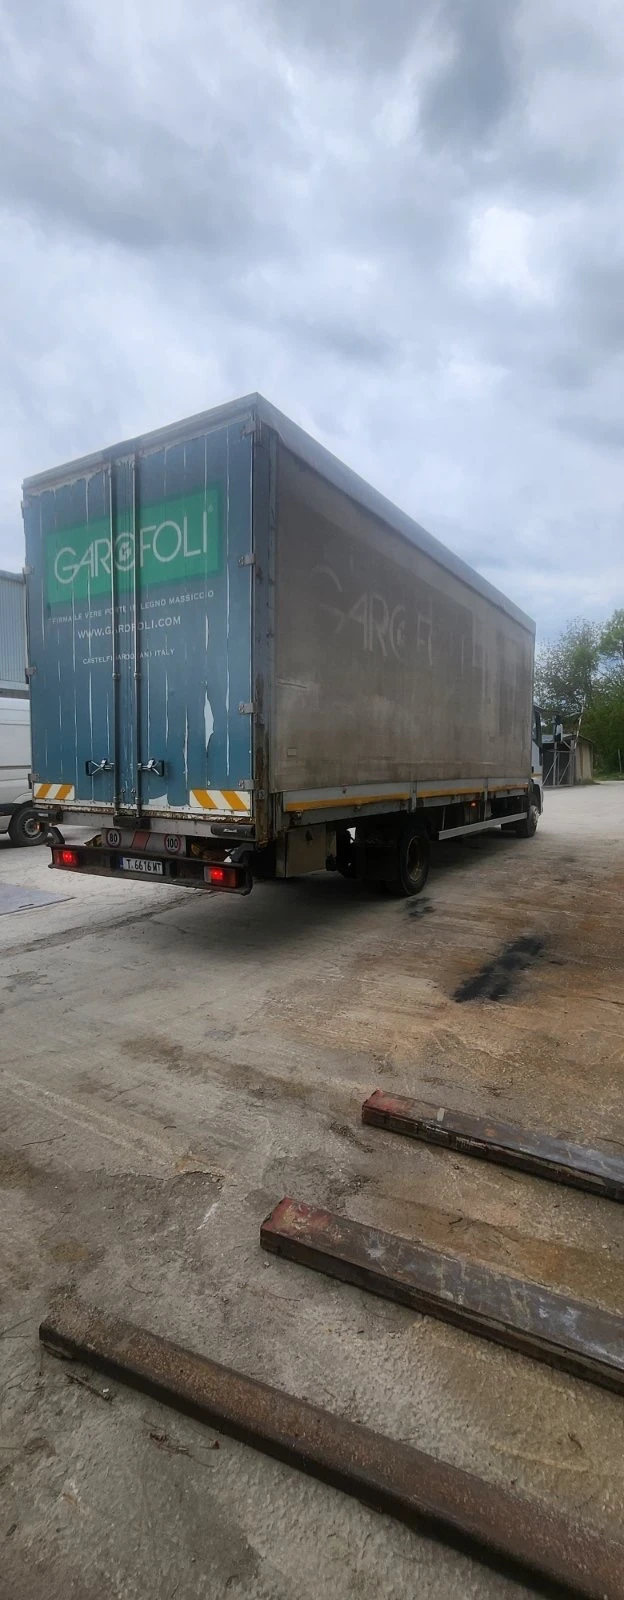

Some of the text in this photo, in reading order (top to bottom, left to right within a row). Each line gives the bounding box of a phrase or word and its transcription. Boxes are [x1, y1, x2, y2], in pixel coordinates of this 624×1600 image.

[85, 610, 102, 619] VERE
[105, 605, 126, 615] POTE
[141, 599, 166, 610] LEGNO
[77, 616, 181, 640] WWW.GROFOLI.COM
[82, 654, 135, 665] CASTELFIARDO
[154, 648, 175, 657] ITALY
[109, 833, 118, 843] 80
[167, 838, 179, 848] 100
